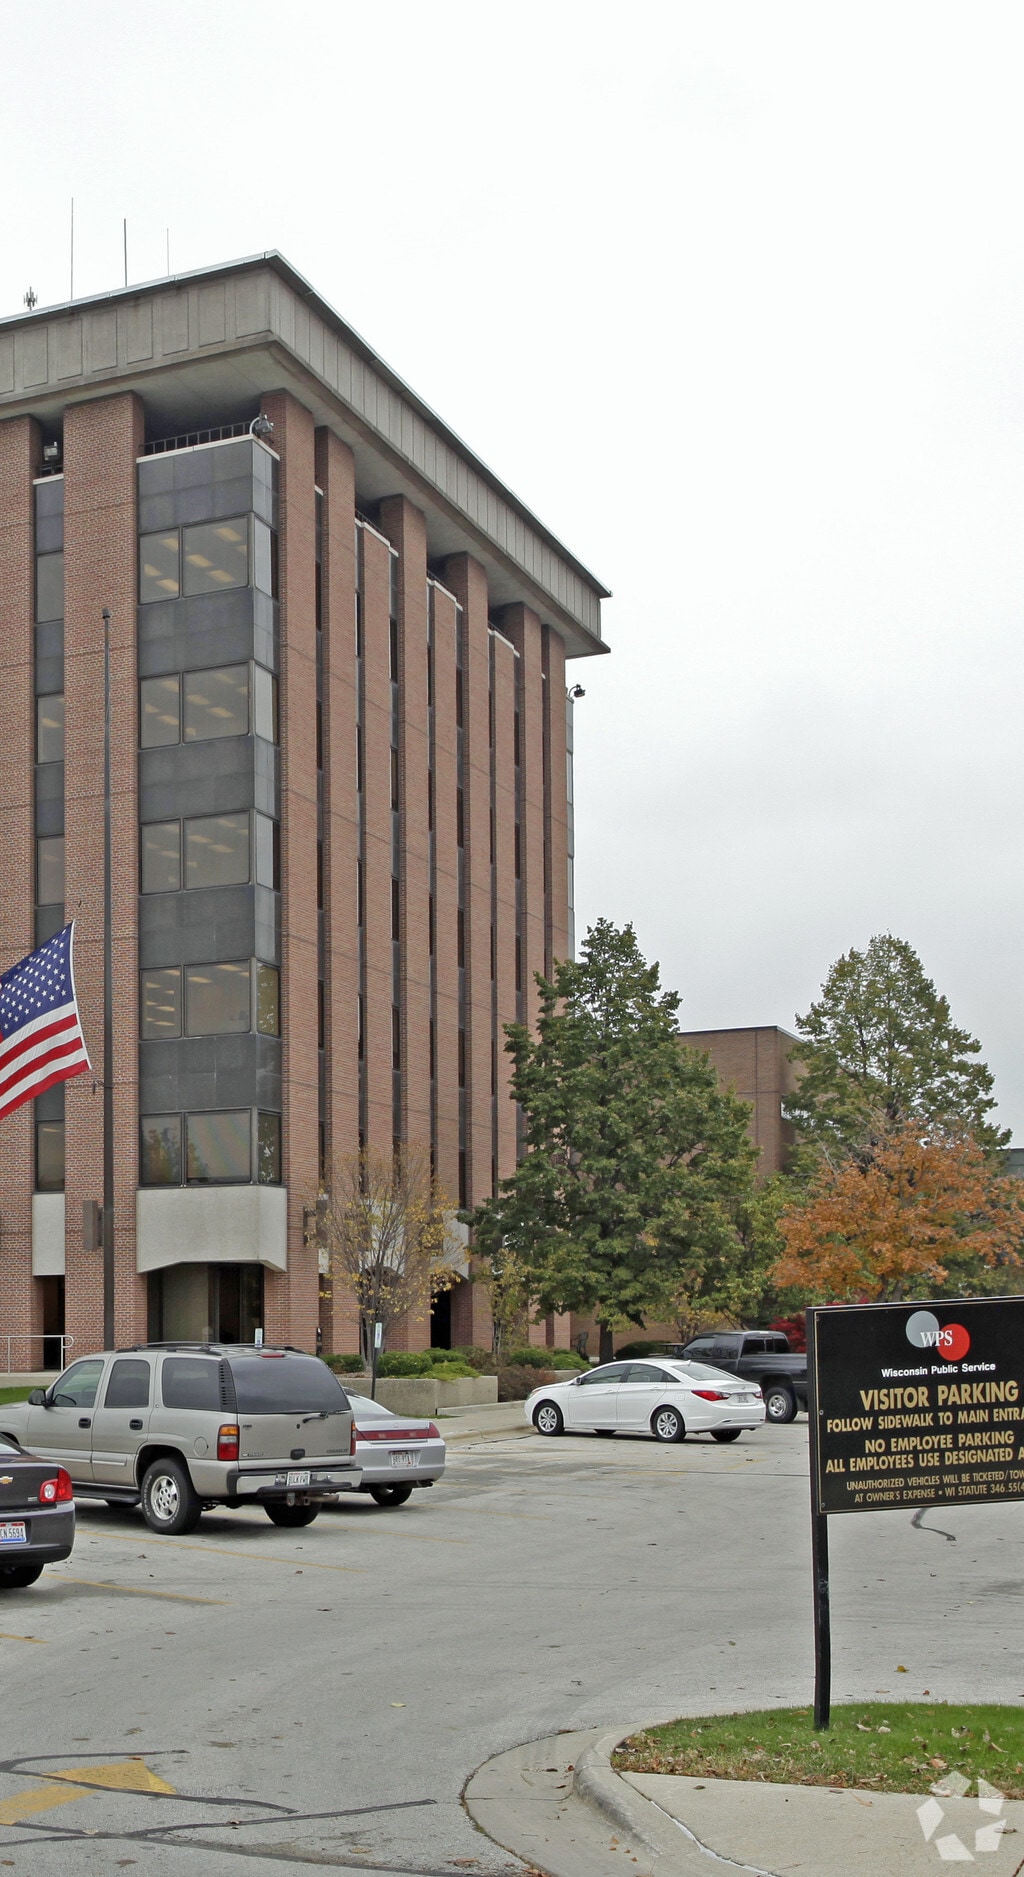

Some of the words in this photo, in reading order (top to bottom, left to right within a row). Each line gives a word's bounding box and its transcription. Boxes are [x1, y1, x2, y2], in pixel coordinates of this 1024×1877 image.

[920, 1330, 953, 1347] WPS
[881, 1367, 927, 1378] Wisconsin
[931, 1365, 958, 1374] Public
[962, 1362, 996, 1372] Service
[860, 1386, 929, 1410] VISITOR
[938, 1380, 1019, 1406] PARKING
[827, 1417, 873, 1432] FOLLOW
[879, 1413, 934, 1429] SIDEWALK
[938, 1412, 953, 1425] TO
[958, 1410, 988, 1424] MAIN
[865, 1440, 885, 1453] NO
[891, 1435, 953, 1451] EMPLOYEE
[959, 1430, 1014, 1447] PARKING
[826, 1459, 845, 1473] ALL
[850, 1454, 914, 1471] EMPLOYEES
[919, 1453, 939, 1467] USE
[945, 1447, 1013, 1464] DESIGNATED
[847, 1478, 904, 1490] UNAUTHORIZED
[907, 1476, 940, 1486] VEHICLES
[943, 1474, 959, 1483] WILL
[962, 1474, 970, 1482] BE
[855, 1493, 863, 1502] AT
[867, 1490, 900, 1502] OWNER'S
[904, 1489, 935, 1499] EXPENSE
[945, 1487, 955, 1496] WI
[958, 1485, 987, 1495] STATUTE
